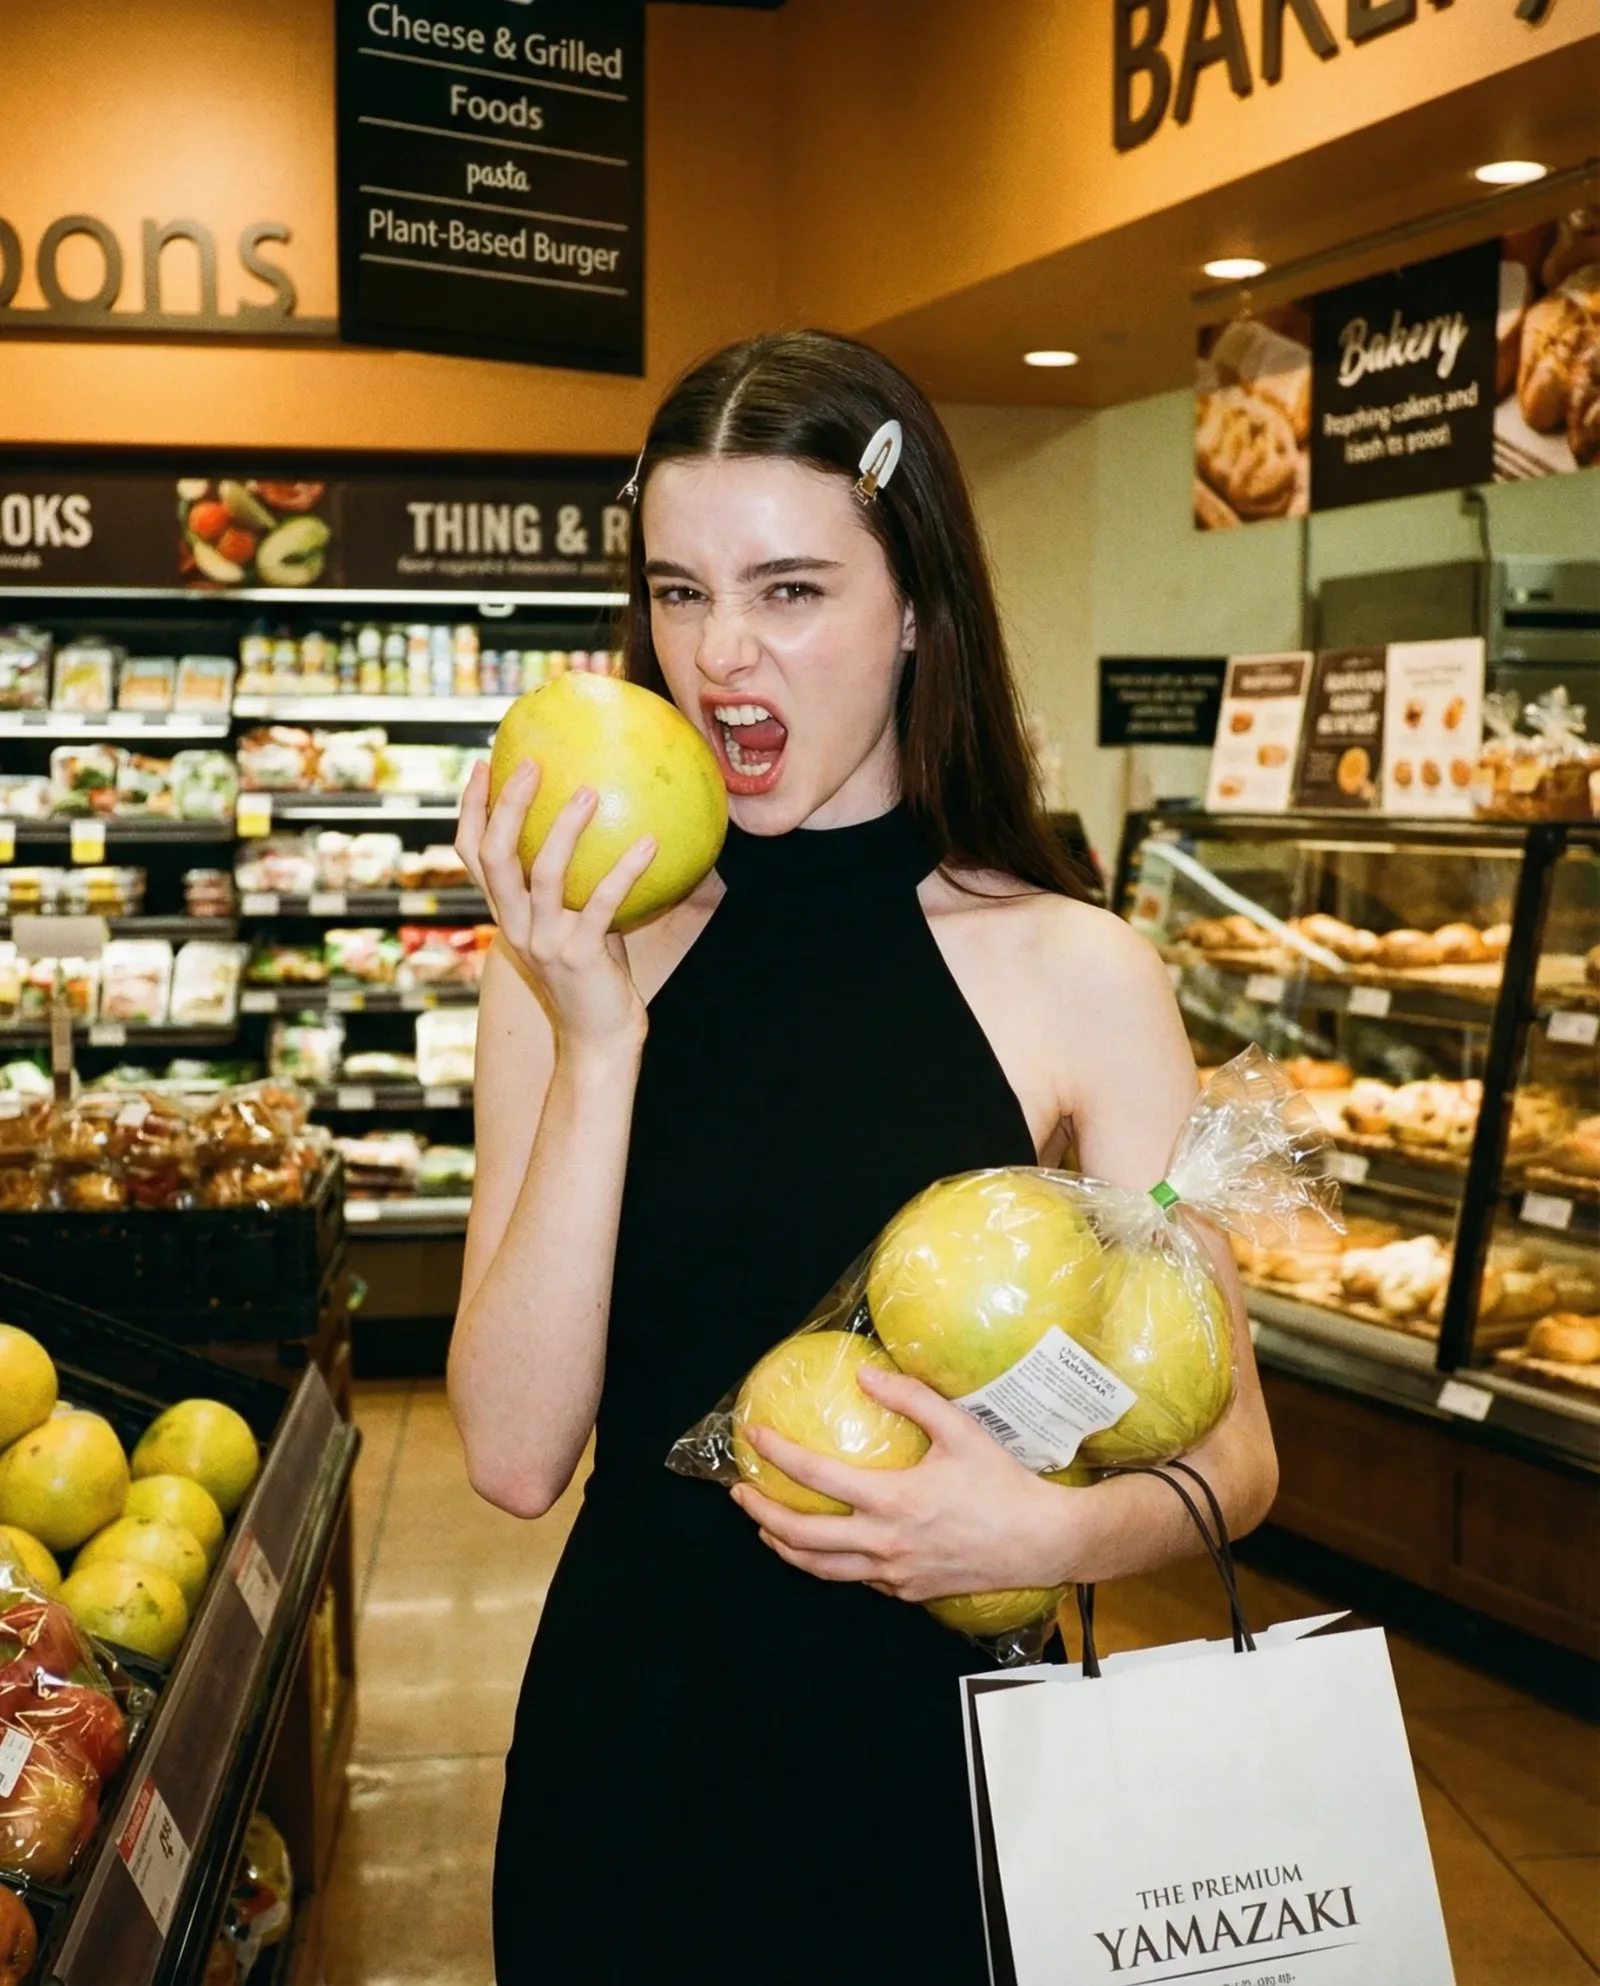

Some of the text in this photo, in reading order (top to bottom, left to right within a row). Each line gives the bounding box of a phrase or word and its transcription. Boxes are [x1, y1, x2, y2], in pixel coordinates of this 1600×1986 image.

[367, 2, 622, 80] Cheese & Grilled
[450, 84, 544, 130] Foods
[466, 160, 531, 194] pasta
[0, 214, 297, 318] ons
[369, 208, 620, 277] Plant-Based Burger
[1336, 309, 1469, 388] Bakery
[1, 493, 93, 548] OKS
[406, 502, 541, 554] THING
[555, 504, 588, 555] &
[1136, 1864, 1303, 1911] THE PREMIUM
[1093, 1885, 1361, 1973] YAMAZAKI
